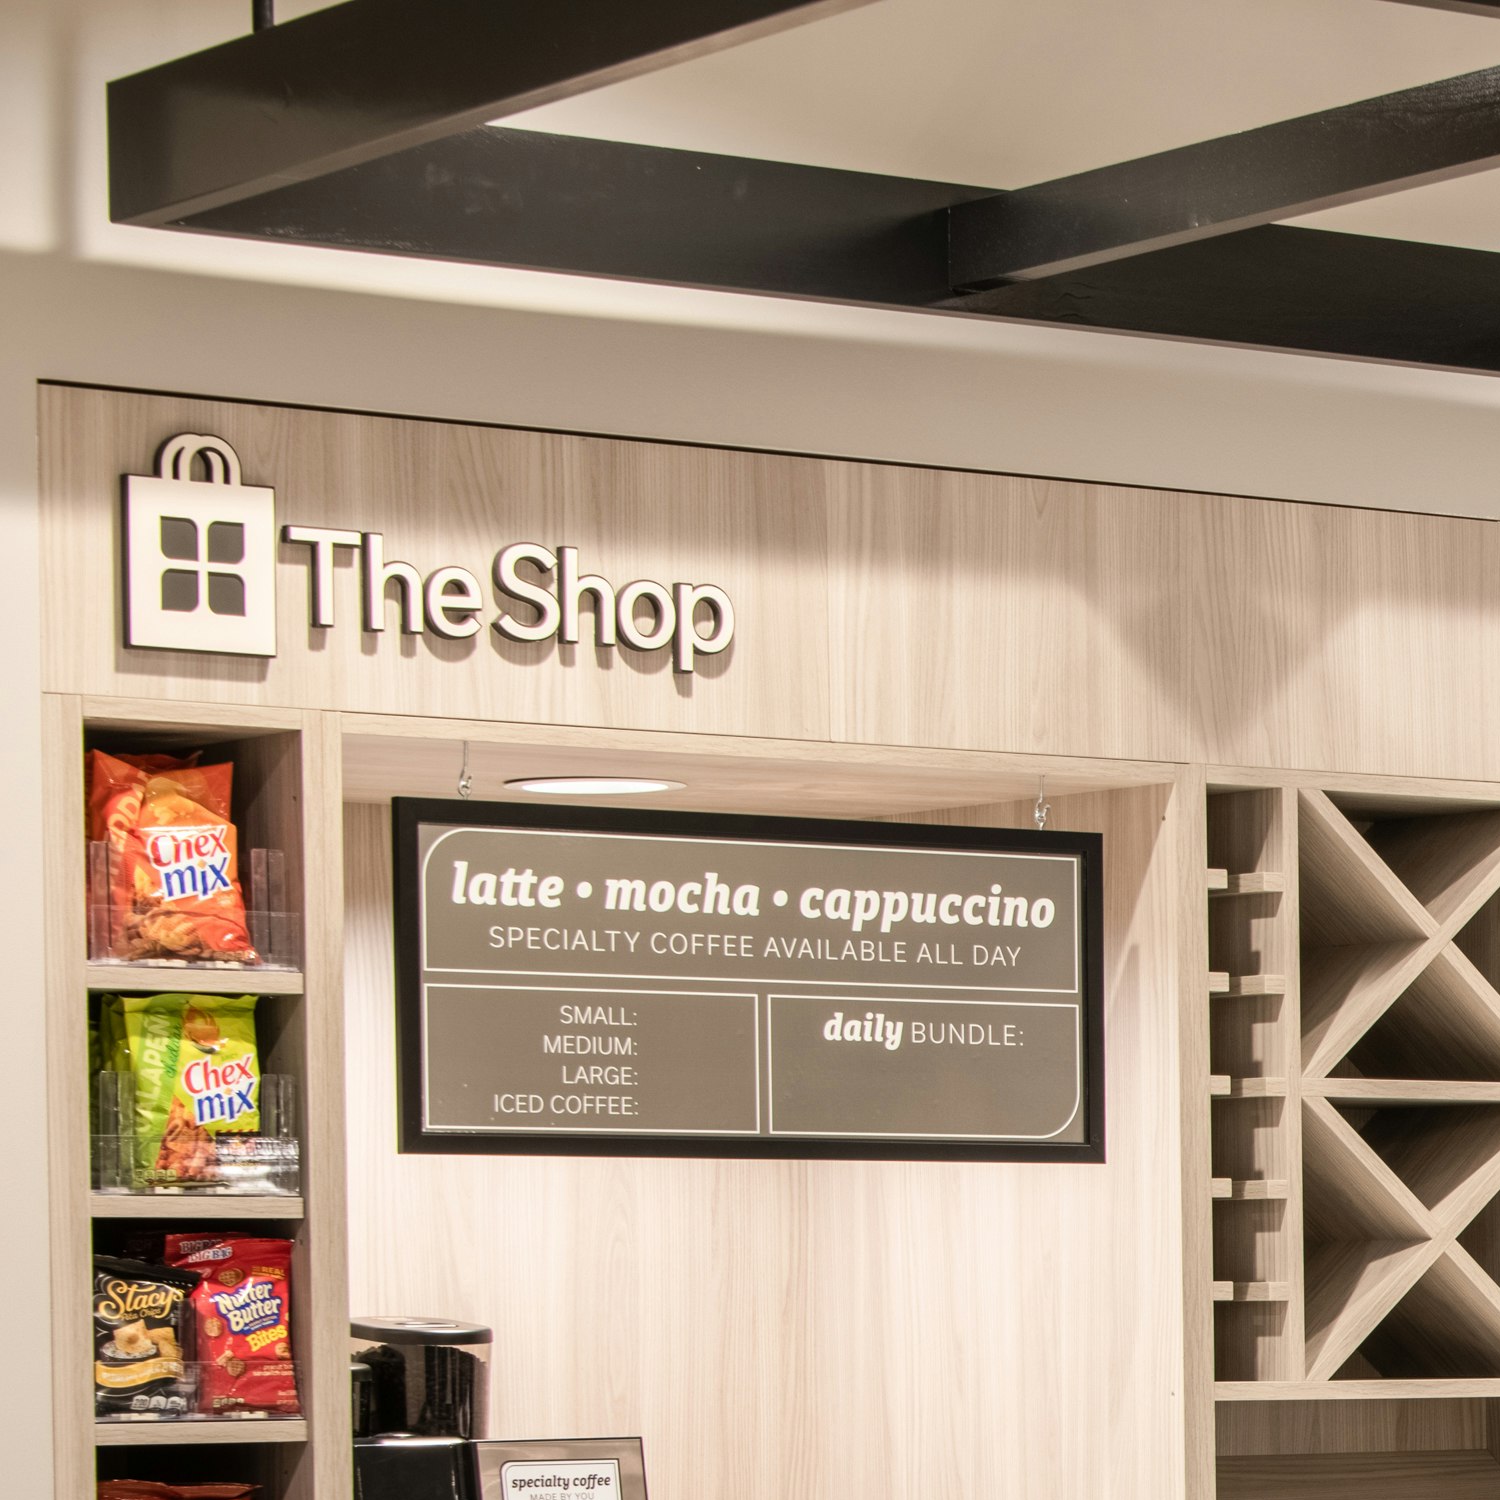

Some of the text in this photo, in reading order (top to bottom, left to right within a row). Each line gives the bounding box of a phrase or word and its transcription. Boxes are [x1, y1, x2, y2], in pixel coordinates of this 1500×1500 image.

[150, 829, 228, 868] Chex
[164, 856, 231, 897] mix
[450, 861, 1055, 933] latte mocha cappuccino
[488, 925, 1022, 967] SPECIALTY COFFEE AVAILABLE ALL DAY
[560, 1005, 638, 1027] SMALL:
[822, 1012, 1025, 1051] daily BUNDLE:
[543, 1035, 638, 1056] MEDIUM:
[184, 1056, 254, 1094] Chex
[561, 1065, 638, 1087] LARGE:
[197, 1081, 255, 1122] mix
[494, 1095, 639, 1116] ICED COFFEE:
[99, 1280, 185, 1320] Stacy's
[227, 1297, 281, 1332] Butter
[246, 1325, 288, 1352] Bites
[512, 1474, 611, 1491] specialty coffee
[530, 1492, 595, 1500] MADE BY YOU
